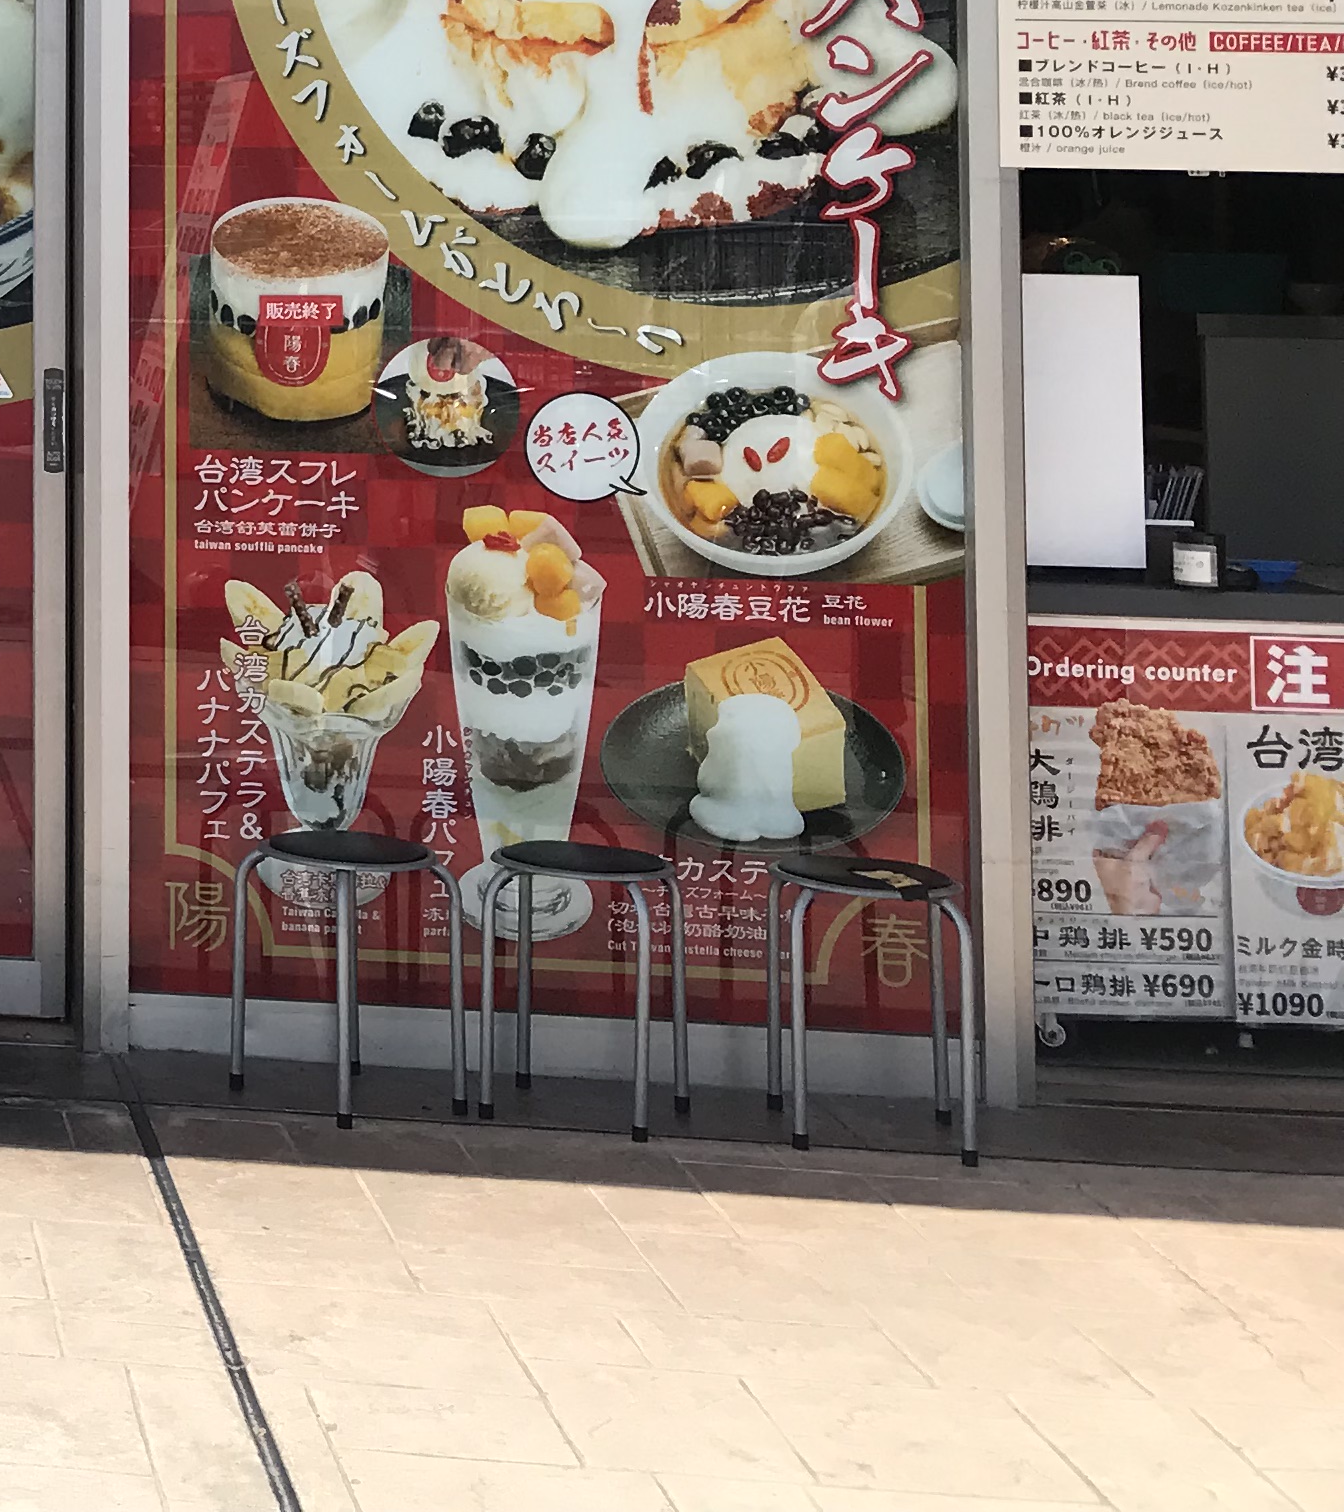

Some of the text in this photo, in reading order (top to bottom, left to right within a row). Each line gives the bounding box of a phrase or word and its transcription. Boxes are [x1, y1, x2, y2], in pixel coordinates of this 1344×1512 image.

[1286, 4, 1305, 13] tea
[1161, 79, 1197, 89] coffee
[1102, 111, 1133, 121] black
[1055, 143, 1126, 156] orange juice
[265, 301, 338, 320] 販売終了
[194, 454, 357, 486] 台湾スフレ
[535, 446, 631, 474] スイーツ
[193, 486, 360, 519] パンケーキ
[194, 539, 324, 554] taiwan pancake
[643, 591, 812, 624] 小陽春豆花
[820, 593, 868, 612] 豆花
[823, 614, 894, 628] bean flower
[1143, 662, 1238, 684] counter
[196, 666, 234, 841] バナナパフェ
[1033, 877, 1092, 903] 890
[608, 940, 627, 952] Cut
[1140, 926, 1213, 953] ¥590
[1143, 973, 1215, 998] ¥690
[1237, 991, 1324, 1018] ¥1090
